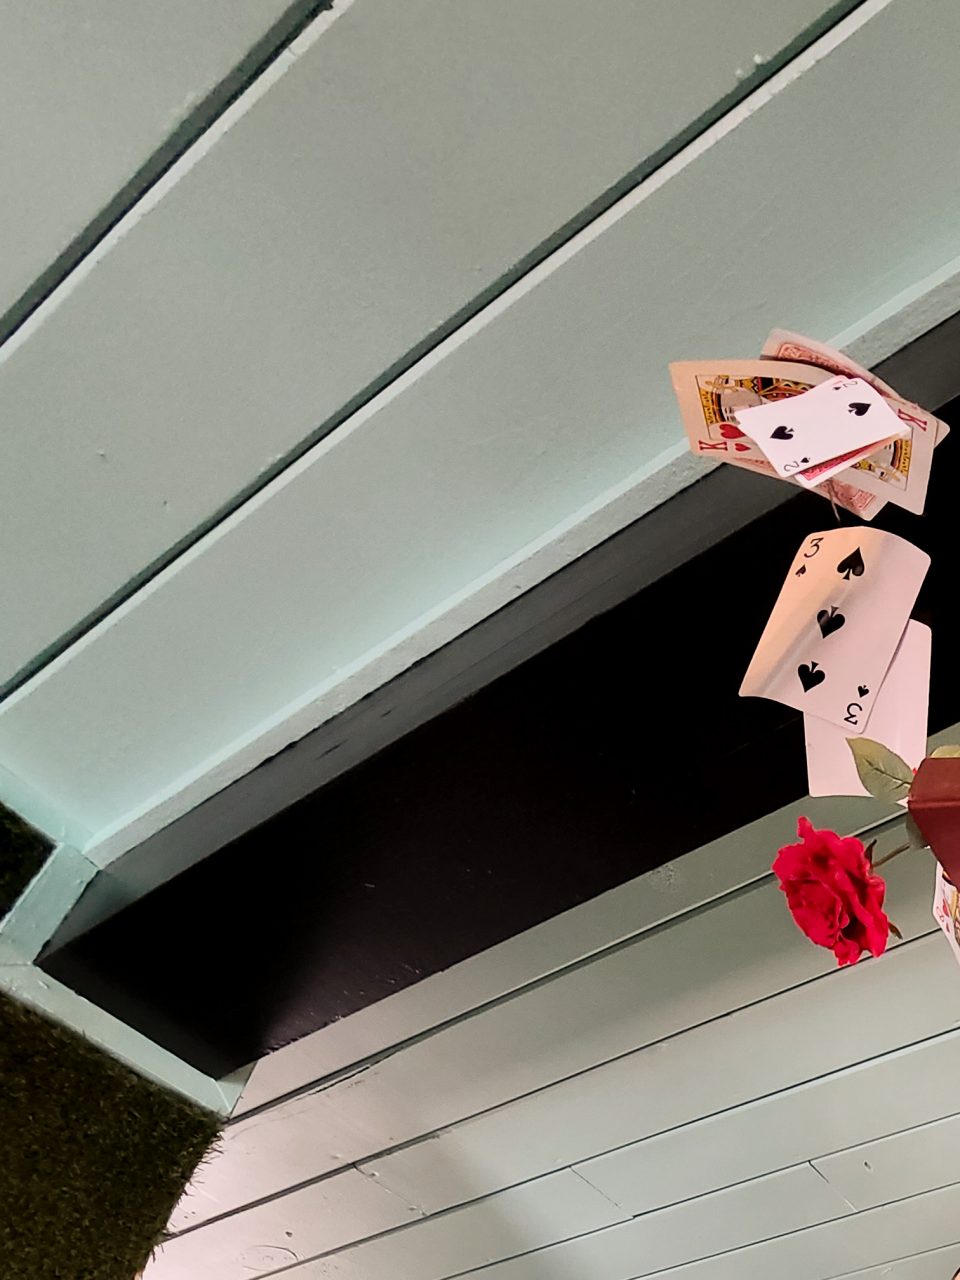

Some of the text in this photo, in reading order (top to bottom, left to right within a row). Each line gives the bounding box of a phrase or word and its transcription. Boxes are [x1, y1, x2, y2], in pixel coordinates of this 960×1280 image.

[897, 408, 928, 431] K
[698, 439, 729, 452] K
[803, 537, 824, 558] 3
[843, 702, 863, 726] 3
